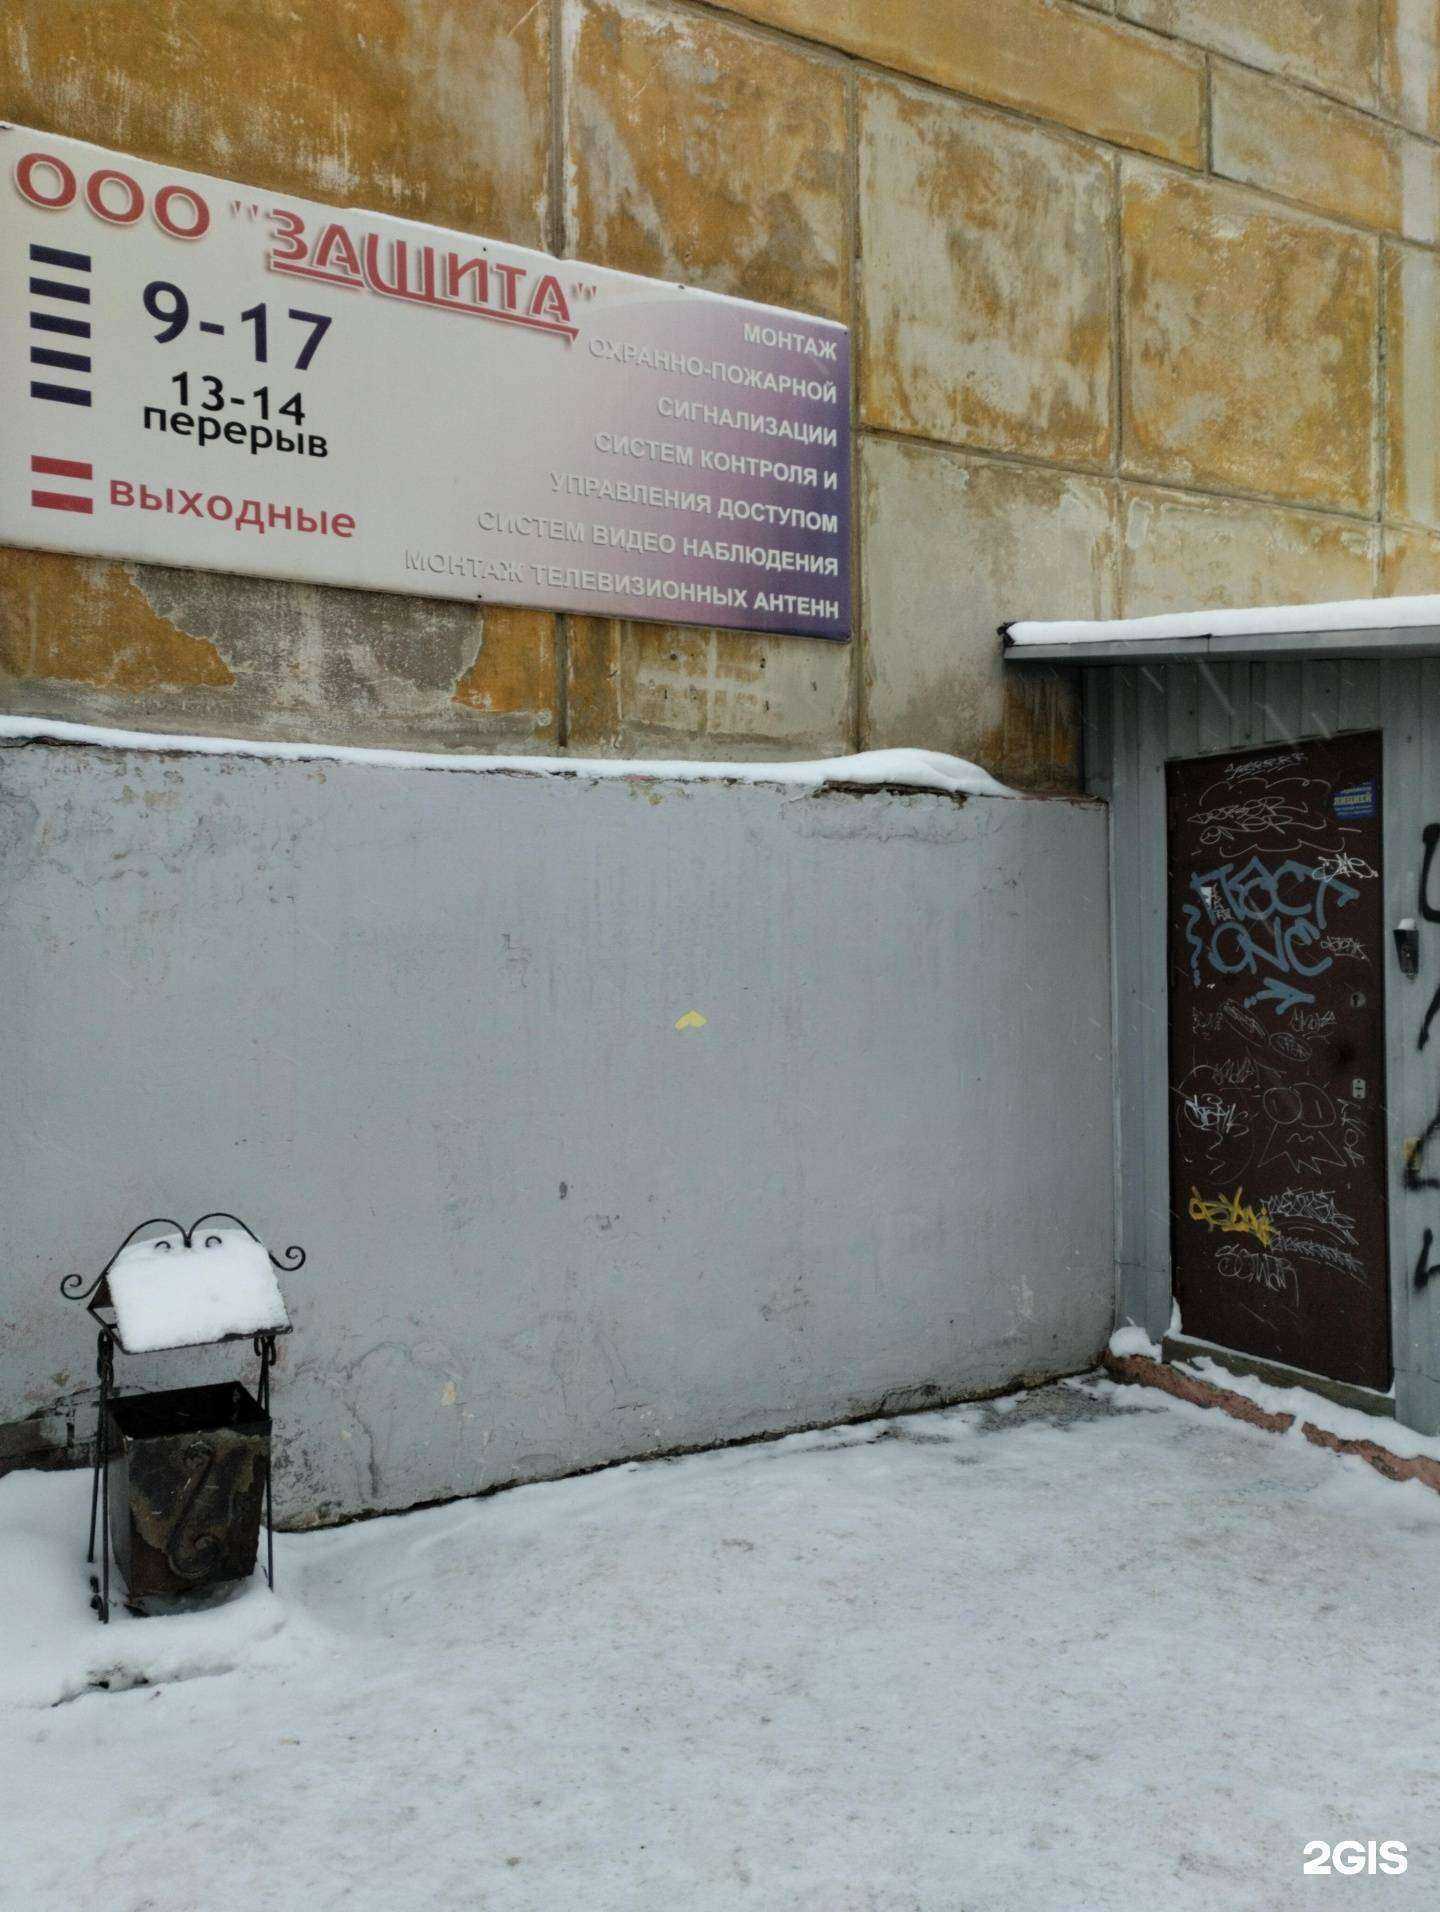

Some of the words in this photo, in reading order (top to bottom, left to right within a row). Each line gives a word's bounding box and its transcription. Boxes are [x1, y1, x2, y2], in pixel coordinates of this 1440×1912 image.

[15, 152, 211, 240] ООО
[142, 281, 333, 371] 9-17
[743, 323, 837, 361] МОНТАЖ
[171, 371, 306, 426] 13-14
[588, 337, 837, 404] ОХРАННО-ПОЖАРНОЙ
[144, 406, 329, 458] перерыв
[656, 396, 838, 447] СИГНАЛИЗАЦИИ
[595, 431, 693, 466] СИСТЕМ
[699, 448, 818, 488] КОНТРОЛЯ
[823, 471, 838, 490] И
[109, 479, 357, 538] выходные
[549, 471, 712, 514] УПРАВЛЕНИЯ
[717, 497, 838, 534] ДОСТУПОМ
[477, 511, 584, 543] СИСТЕМ
[591, 525, 676, 556] ВИДЕО
[683, 537, 839, 577] НАБЛЮДЕНИЯ
[404, 549, 524, 583] МОНТАЖ
[530, 564, 749, 609] ТЕЛЕВИЗИОННЫХ
[753, 593, 839, 620] АНТЕНН
